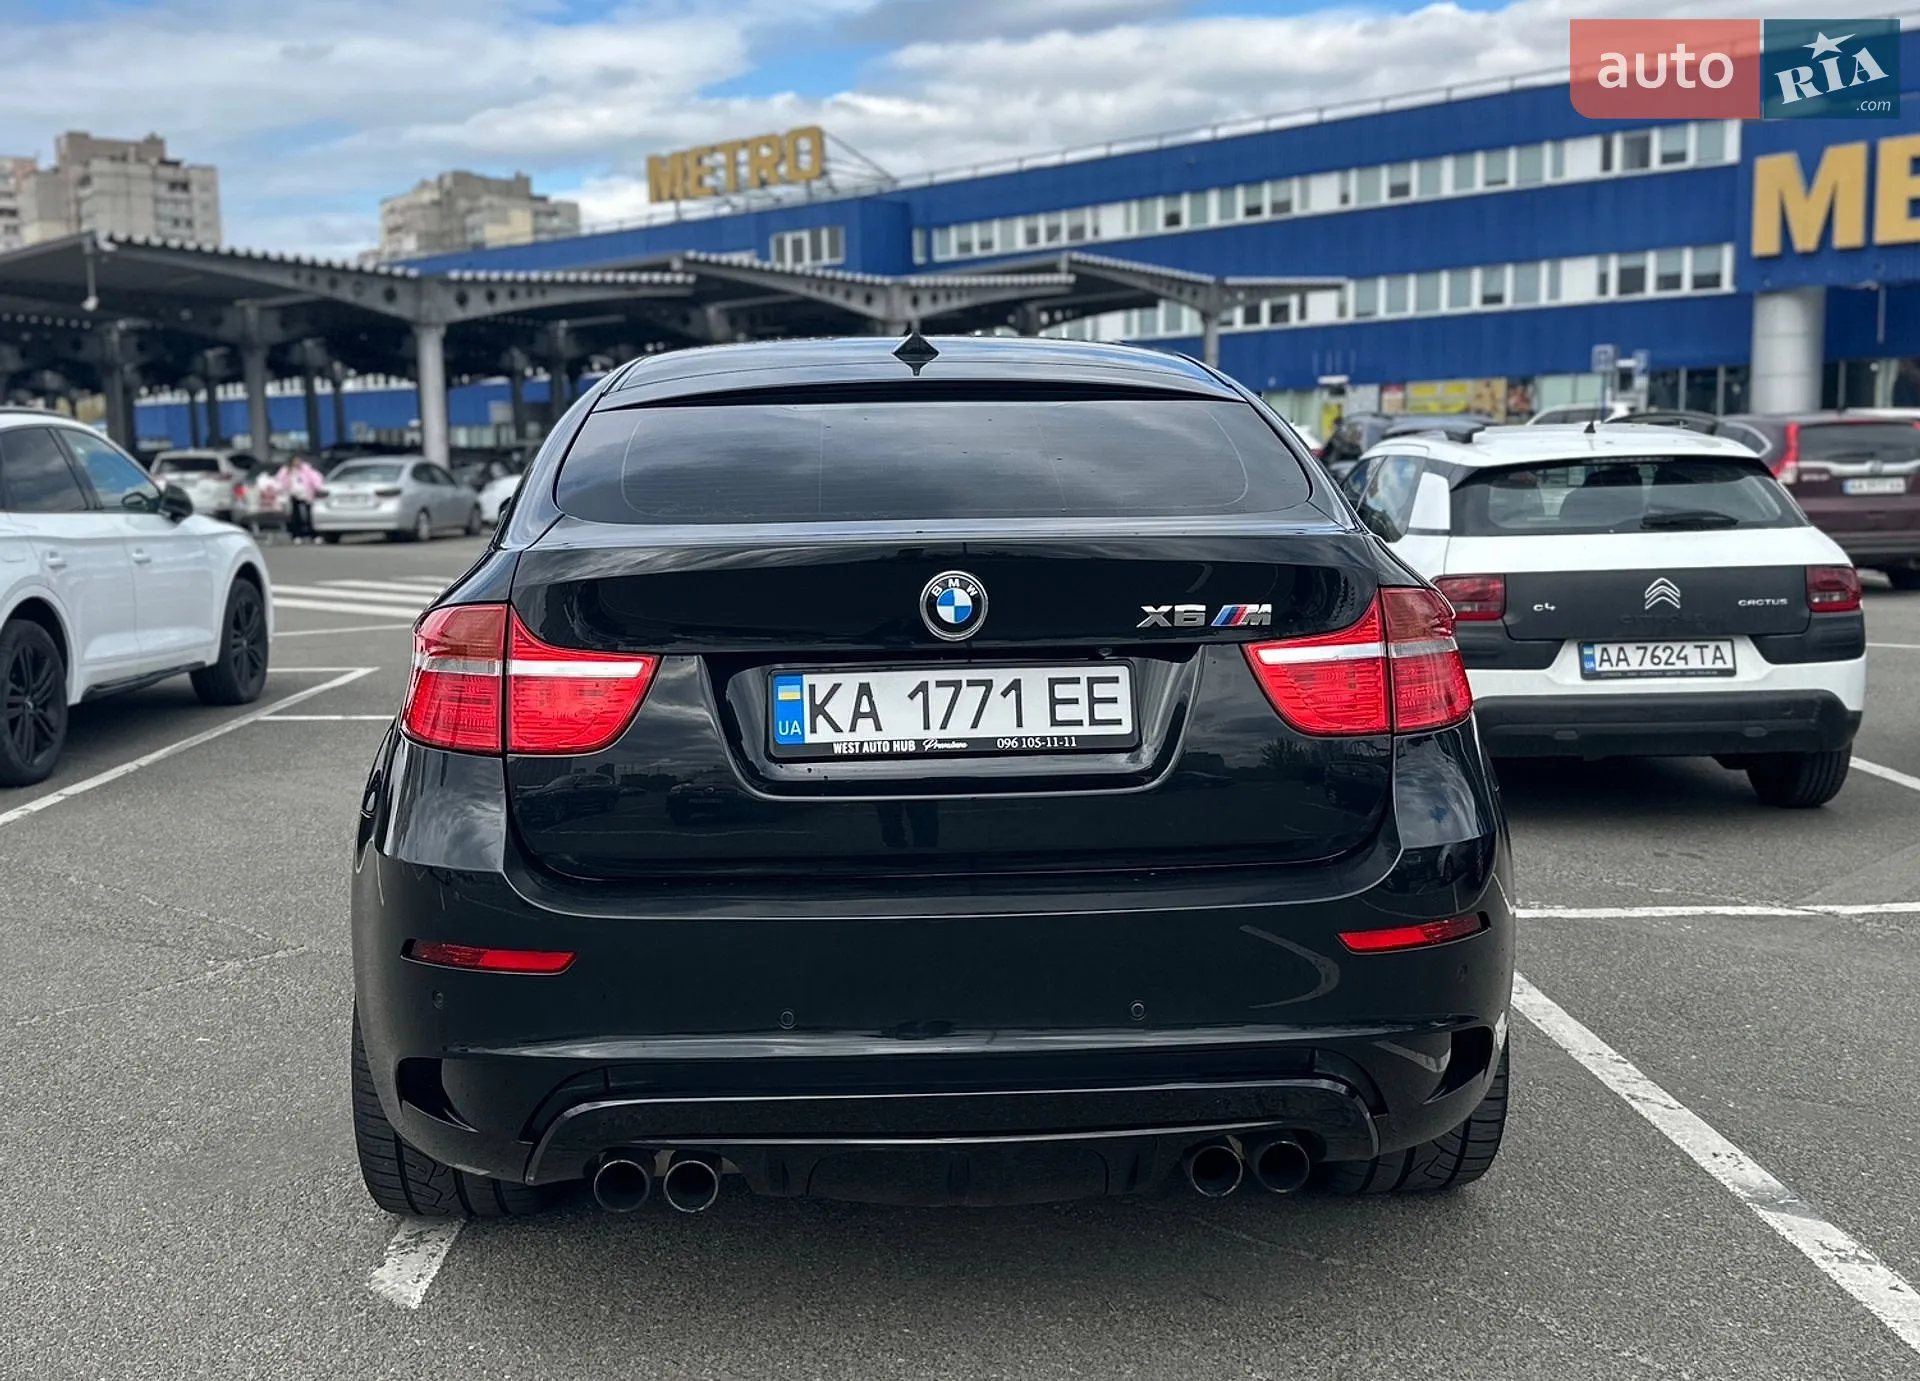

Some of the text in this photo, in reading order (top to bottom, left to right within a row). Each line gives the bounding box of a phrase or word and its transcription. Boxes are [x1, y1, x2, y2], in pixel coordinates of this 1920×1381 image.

[647, 125, 825, 203] METRO
[931, 578, 978, 597] BMW
[1738, 597, 1788, 607] CACTUS
[1598, 643, 1727, 668] AA 7624 TA
[808, 675, 1123, 735] KA 1771 EE
[778, 720, 802, 737] UA
[832, 741, 861, 755] WEST
[862, 740, 890, 754] AUTO
[892, 739, 916, 752] HUB
[996, 737, 1018, 750] 096
[1021, 736, 1077, 749] 105-11-11
